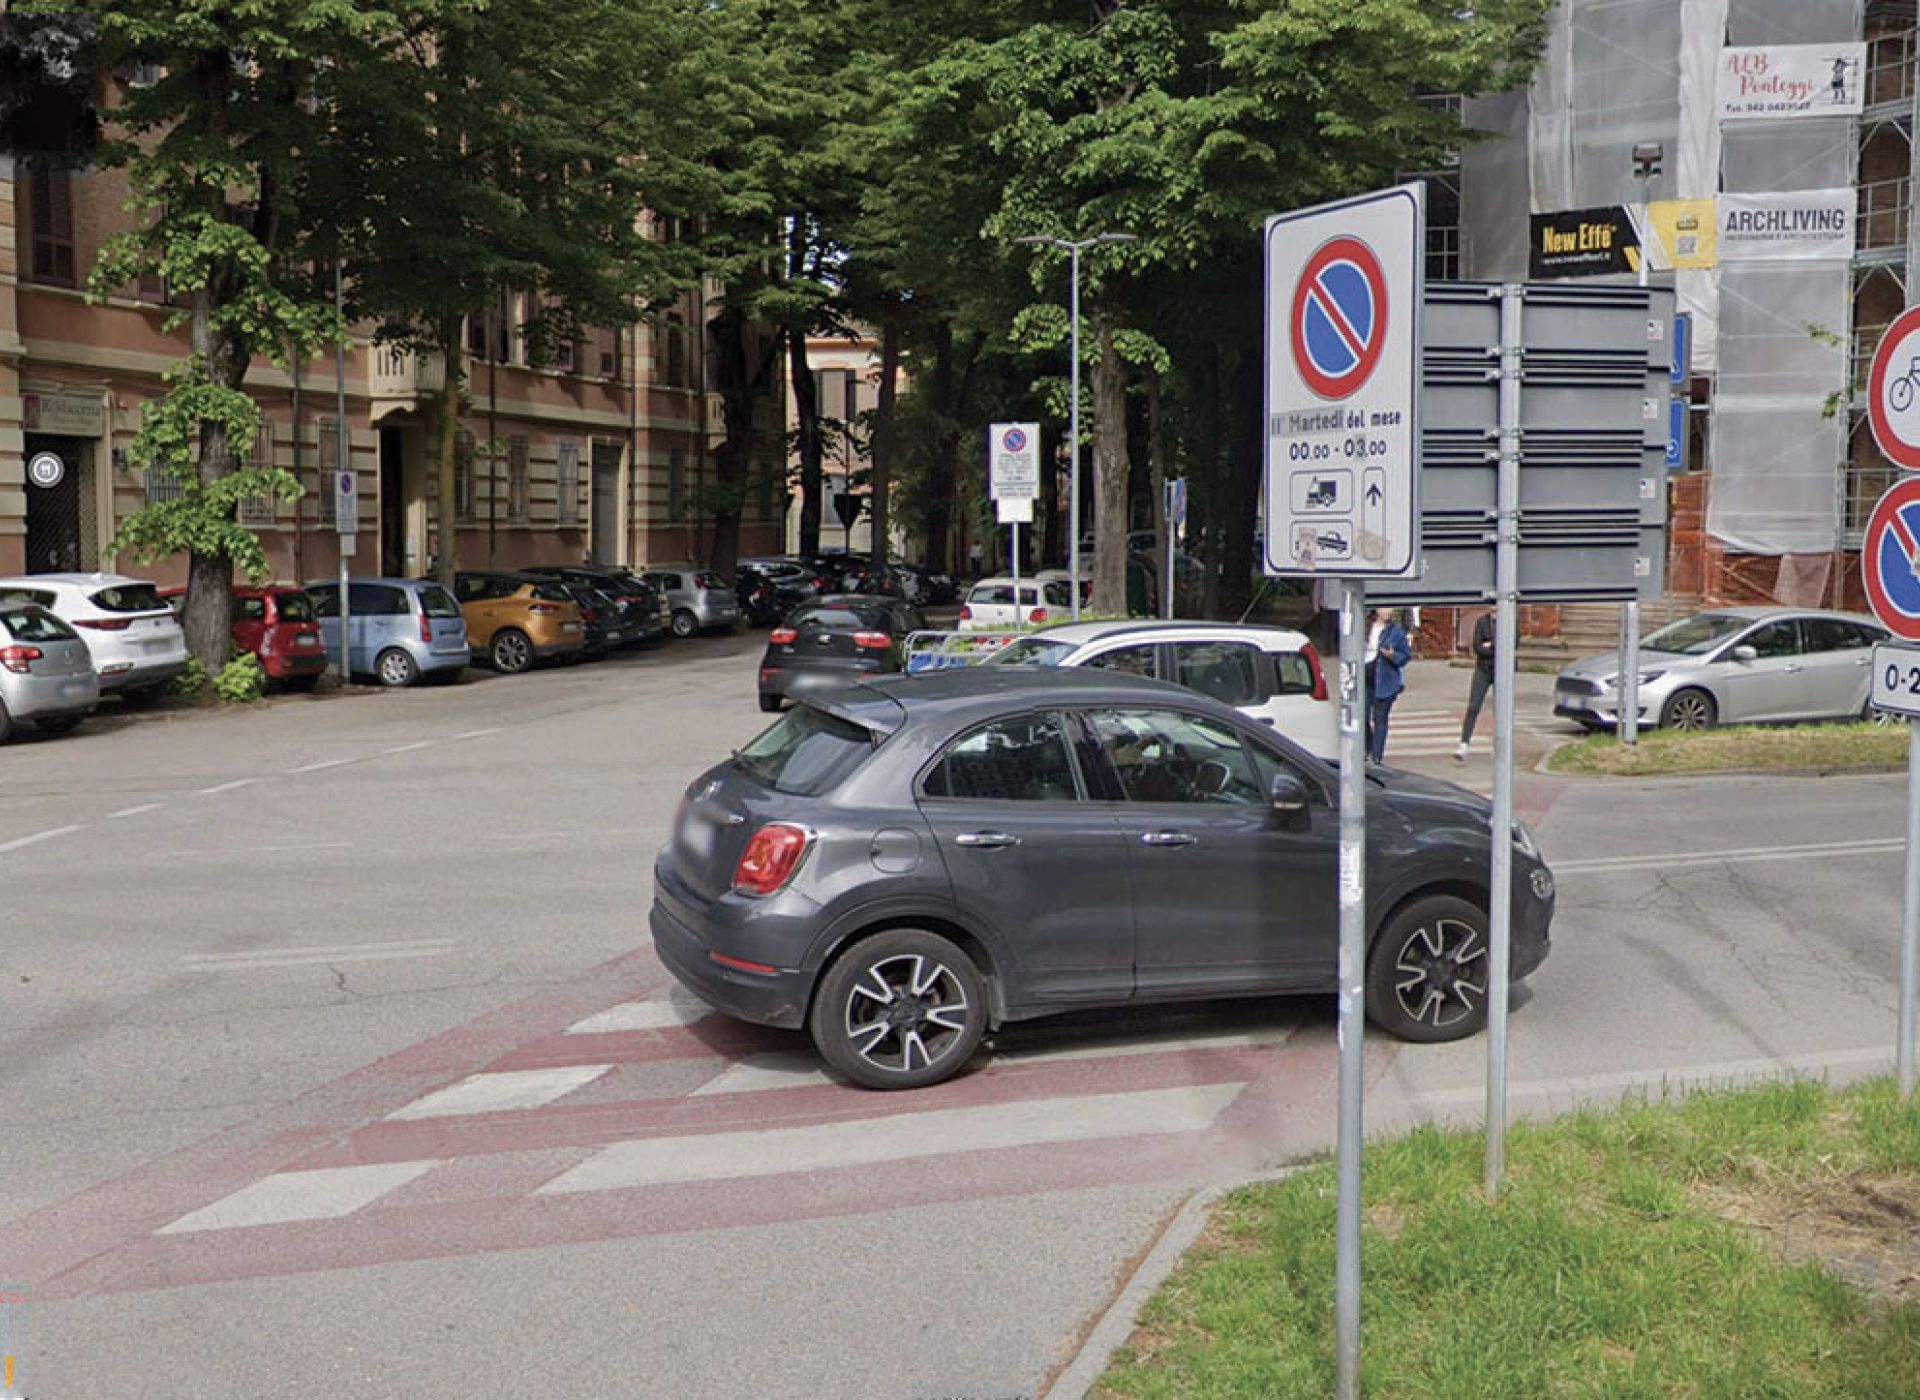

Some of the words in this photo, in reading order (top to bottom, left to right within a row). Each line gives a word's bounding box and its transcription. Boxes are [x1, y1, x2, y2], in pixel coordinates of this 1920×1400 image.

[1726, 209, 1845, 231] ARCHLIVING
[1542, 226, 1577, 253] New
[1347, 409, 1367, 428] del
[1370, 411, 1401, 427] mese
[1289, 442, 1330, 461] 00.00
[1345, 438, 1387, 458] 03.00
